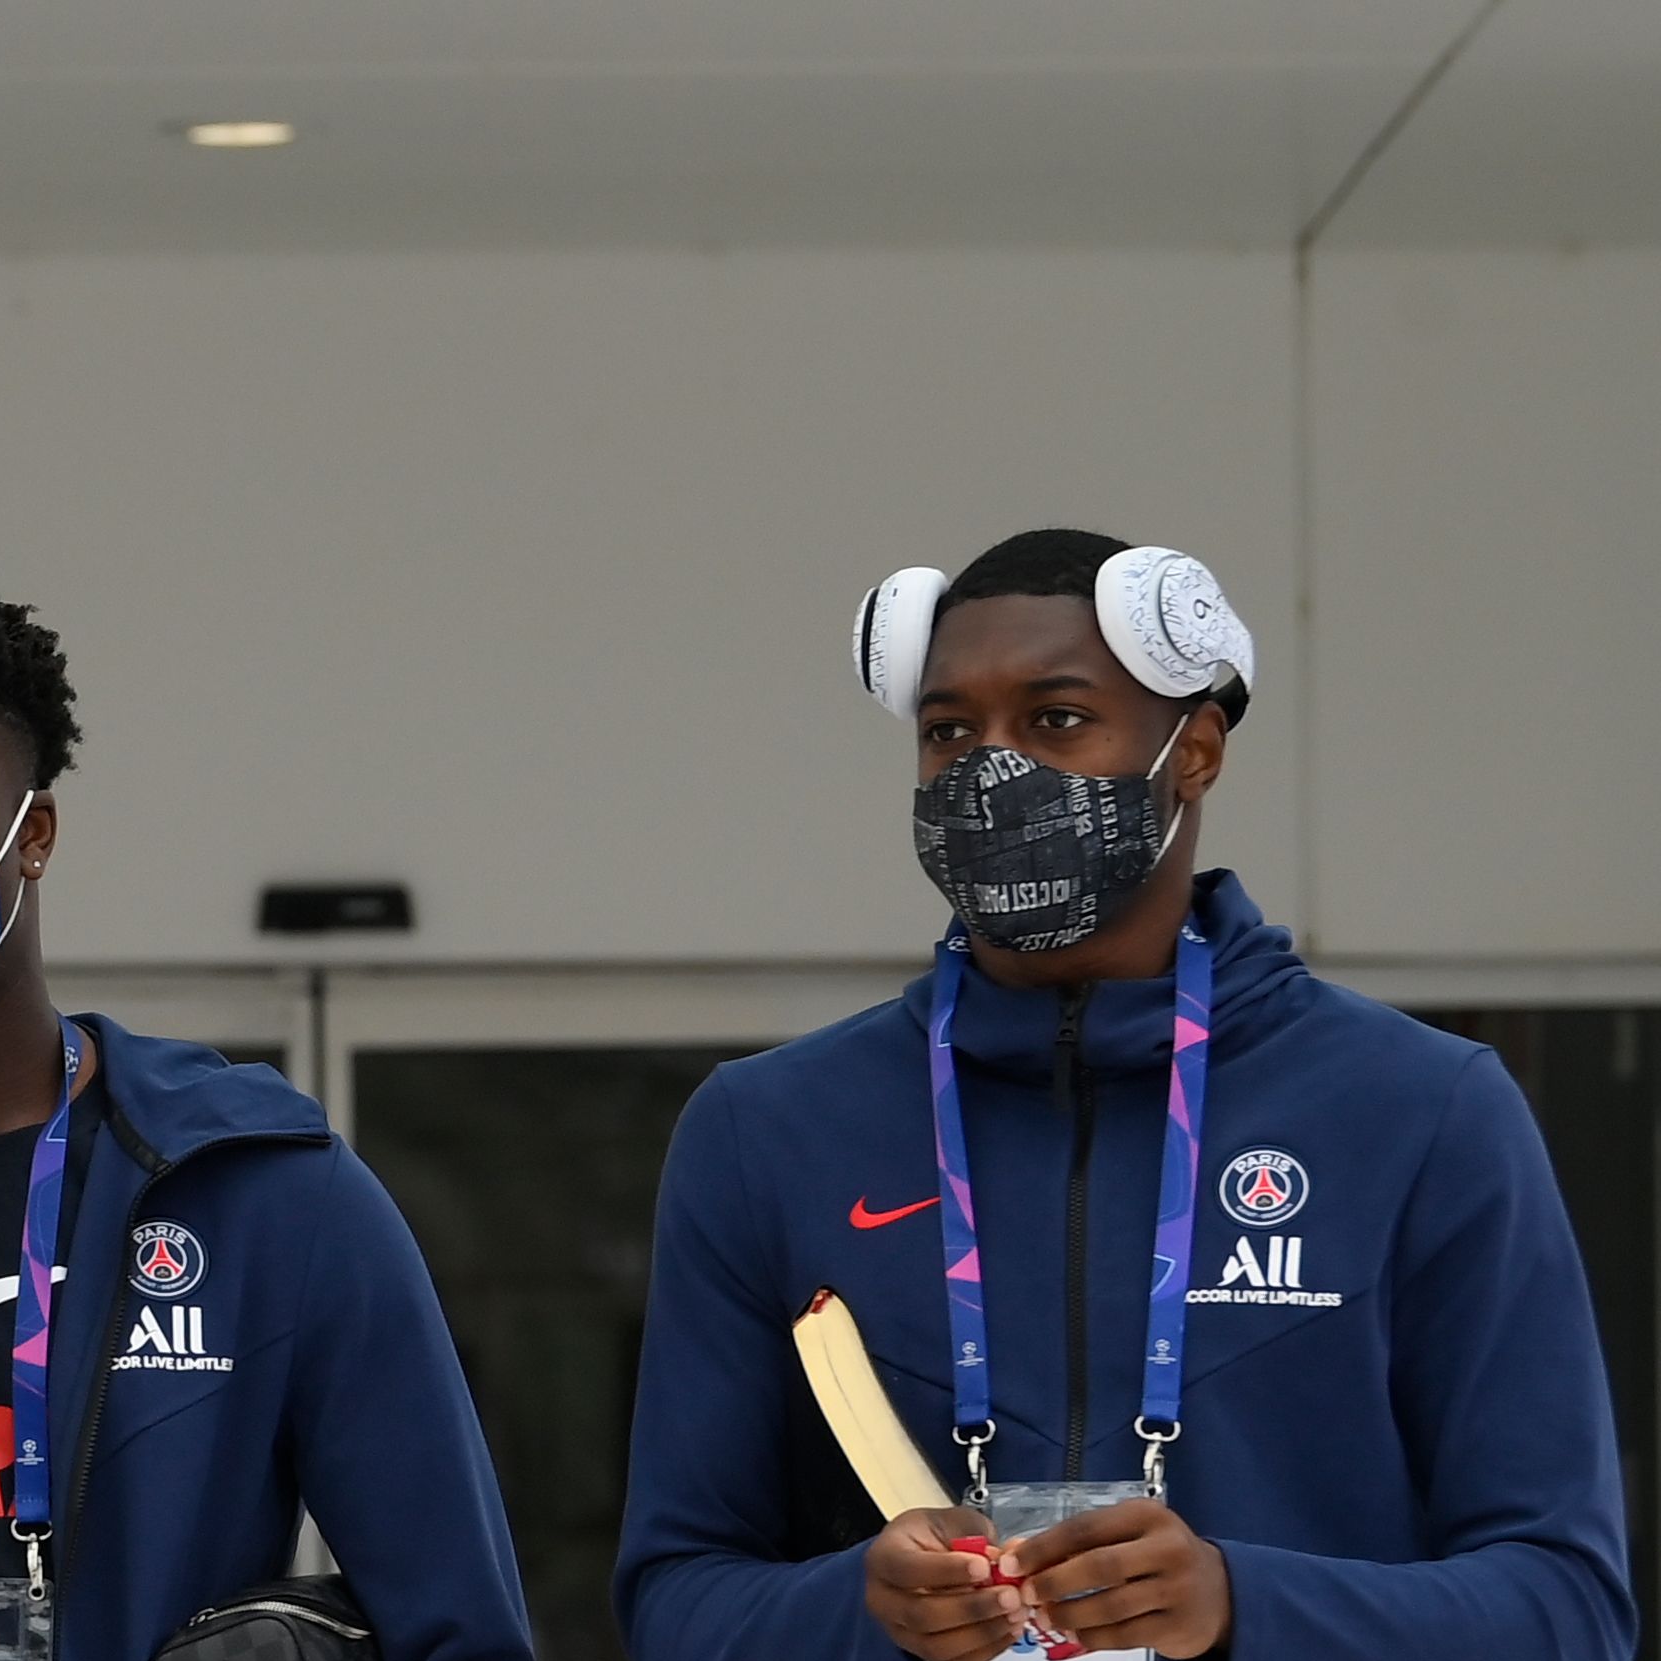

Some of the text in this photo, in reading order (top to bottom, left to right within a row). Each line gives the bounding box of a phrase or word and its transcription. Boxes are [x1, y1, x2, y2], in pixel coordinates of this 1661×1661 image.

[1234, 1155, 1293, 1175] PARIS
[133, 1226, 187, 1245] PARIS
[1184, 1289, 1343, 1307] CCOR LIVE LIMITLESS
[143, 1355, 175, 1370] LIVE
